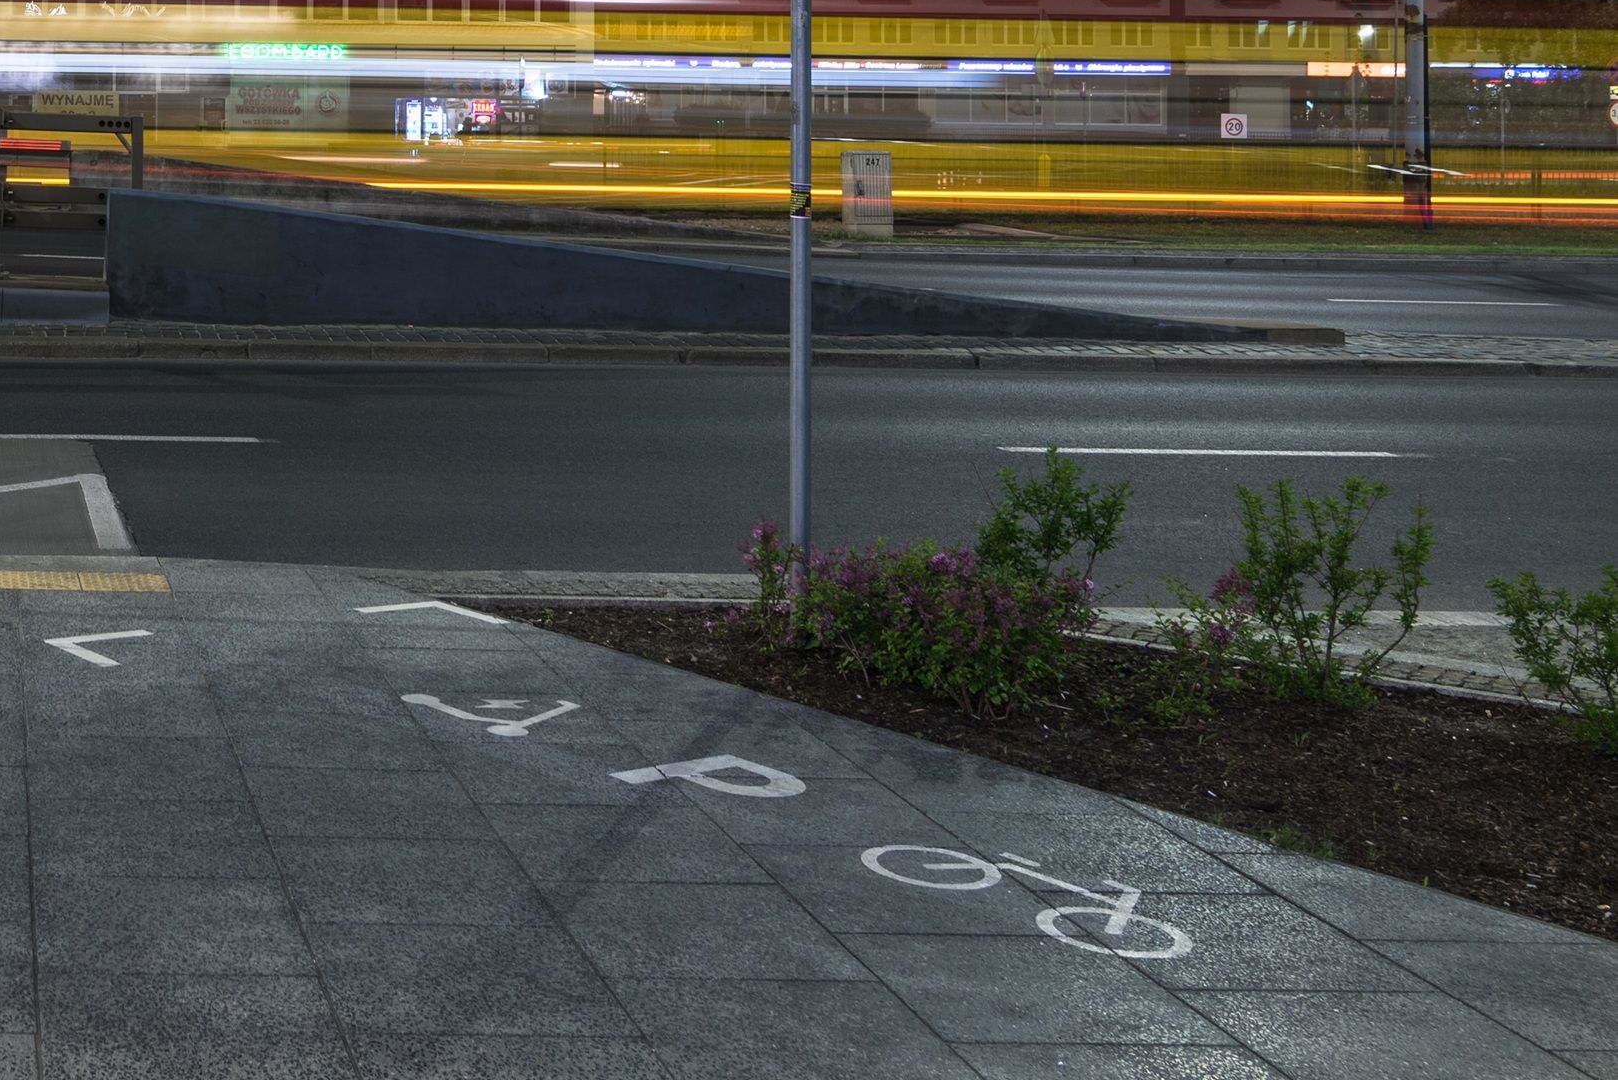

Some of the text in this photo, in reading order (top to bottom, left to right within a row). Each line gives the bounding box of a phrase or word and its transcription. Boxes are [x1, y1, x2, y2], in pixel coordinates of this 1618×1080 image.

[238, 85, 301, 100] GOTÓWKA
[42, 94, 114, 109] WYNAJMĘ
[1228, 122, 1241, 131] 20
[865, 158, 880, 167] 247
